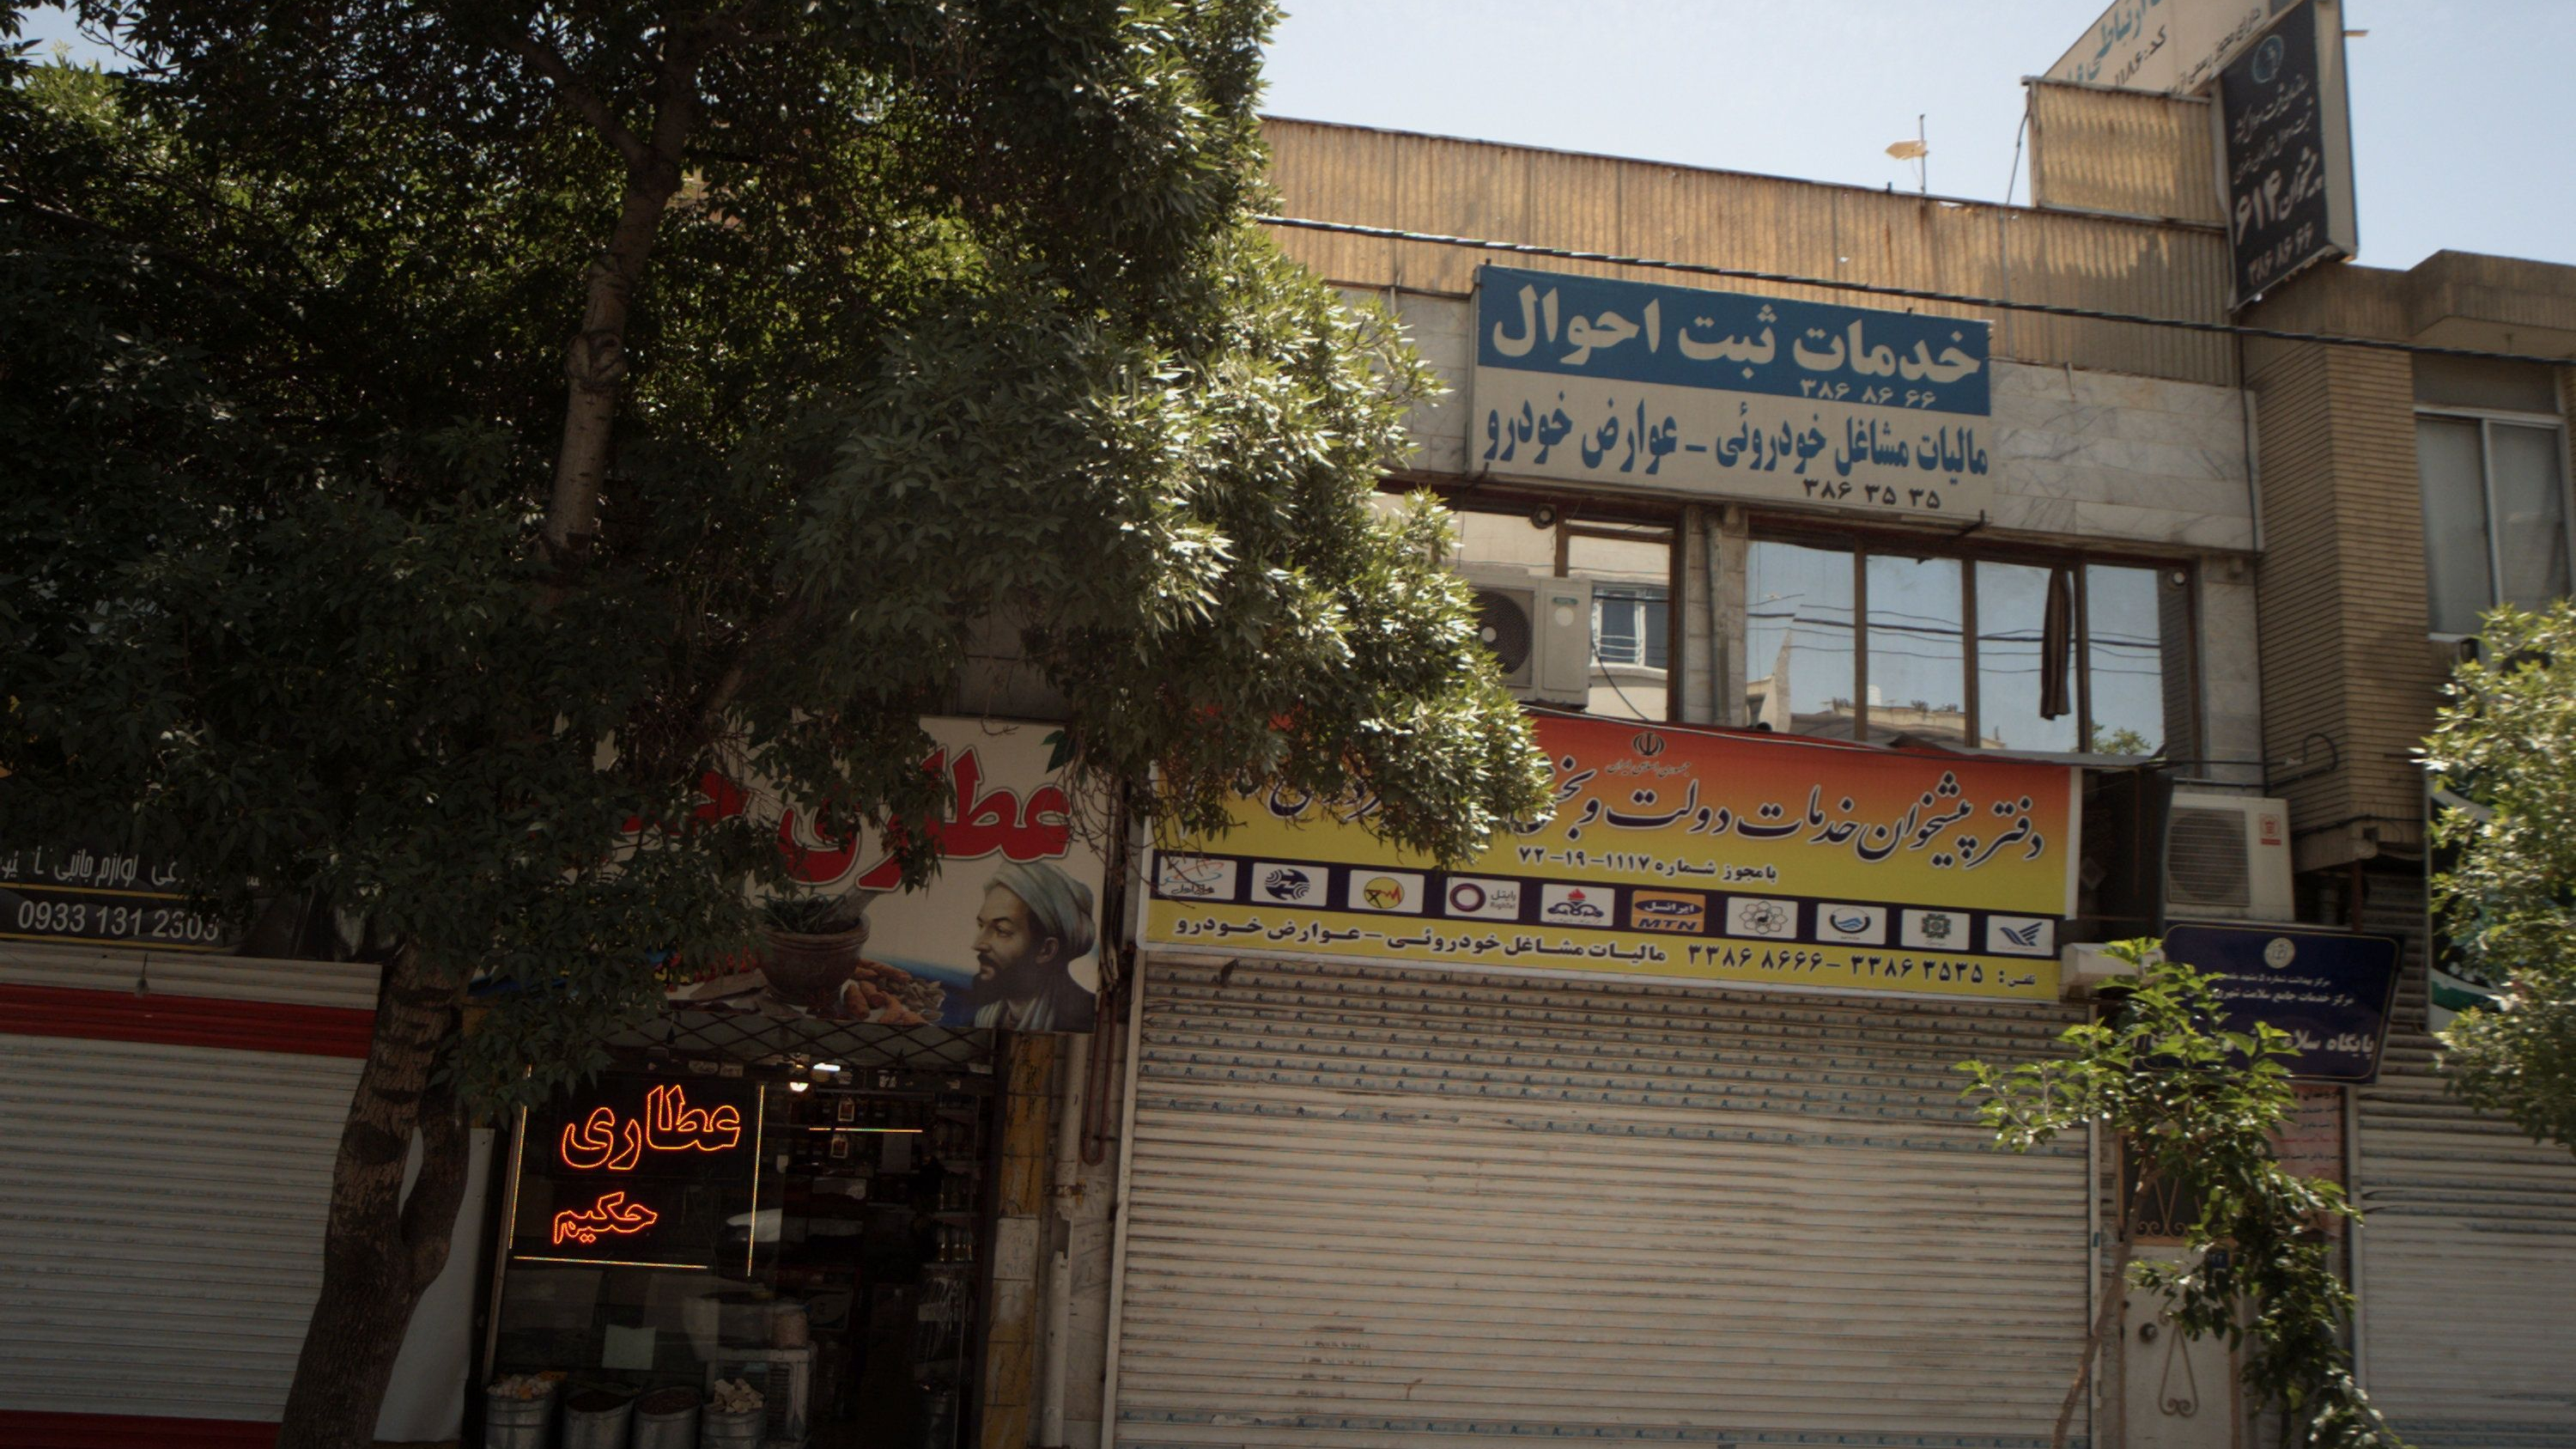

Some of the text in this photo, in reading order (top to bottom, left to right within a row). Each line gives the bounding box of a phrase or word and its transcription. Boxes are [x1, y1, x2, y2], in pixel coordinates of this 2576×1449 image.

[1493, 283, 1981, 383] خدمات ثبت احوال
[1801, 379, 1935, 409] ۳۸۶ ۸۶ ۶۶
[1484, 391, 1572, 464] خودرو
[1582, 397, 1677, 474] عوارض
[1716, 401, 1826, 473] خودروئی
[1835, 416, 1909, 476] مشاغل
[1917, 425, 1988, 485] مالیات
[1803, 478, 1940, 508] ۳۸۶ ۳۵ ۳۵
[1606, 780, 1730, 833] دولت
[1737, 785, 1858, 843] خدمات
[1856, 770, 1977, 866] پیشخوان
[1965, 796, 2043, 868] دفتر
[54, 849, 94, 883] جانبی
[94, 854, 139, 886] لوازم
[1656, 859, 1716, 876] شماره
[18, 900, 86, 932] 0933
[96, 905, 143, 935] 131
[1638, 918, 1698, 931] MTN
[1644, 902, 1695, 913] ایرانسل
[1176, 917, 1262, 935] خودرو
[1267, 921, 1360, 943] عوارض
[1504, 937, 1584, 956] مشاغل
[1589, 942, 1666, 963] مالیات
[2325, 1032, 2376, 1060] پایگاه
[562, 1084, 741, 1170] عطاری
[553, 1191, 659, 1245] حکیم
